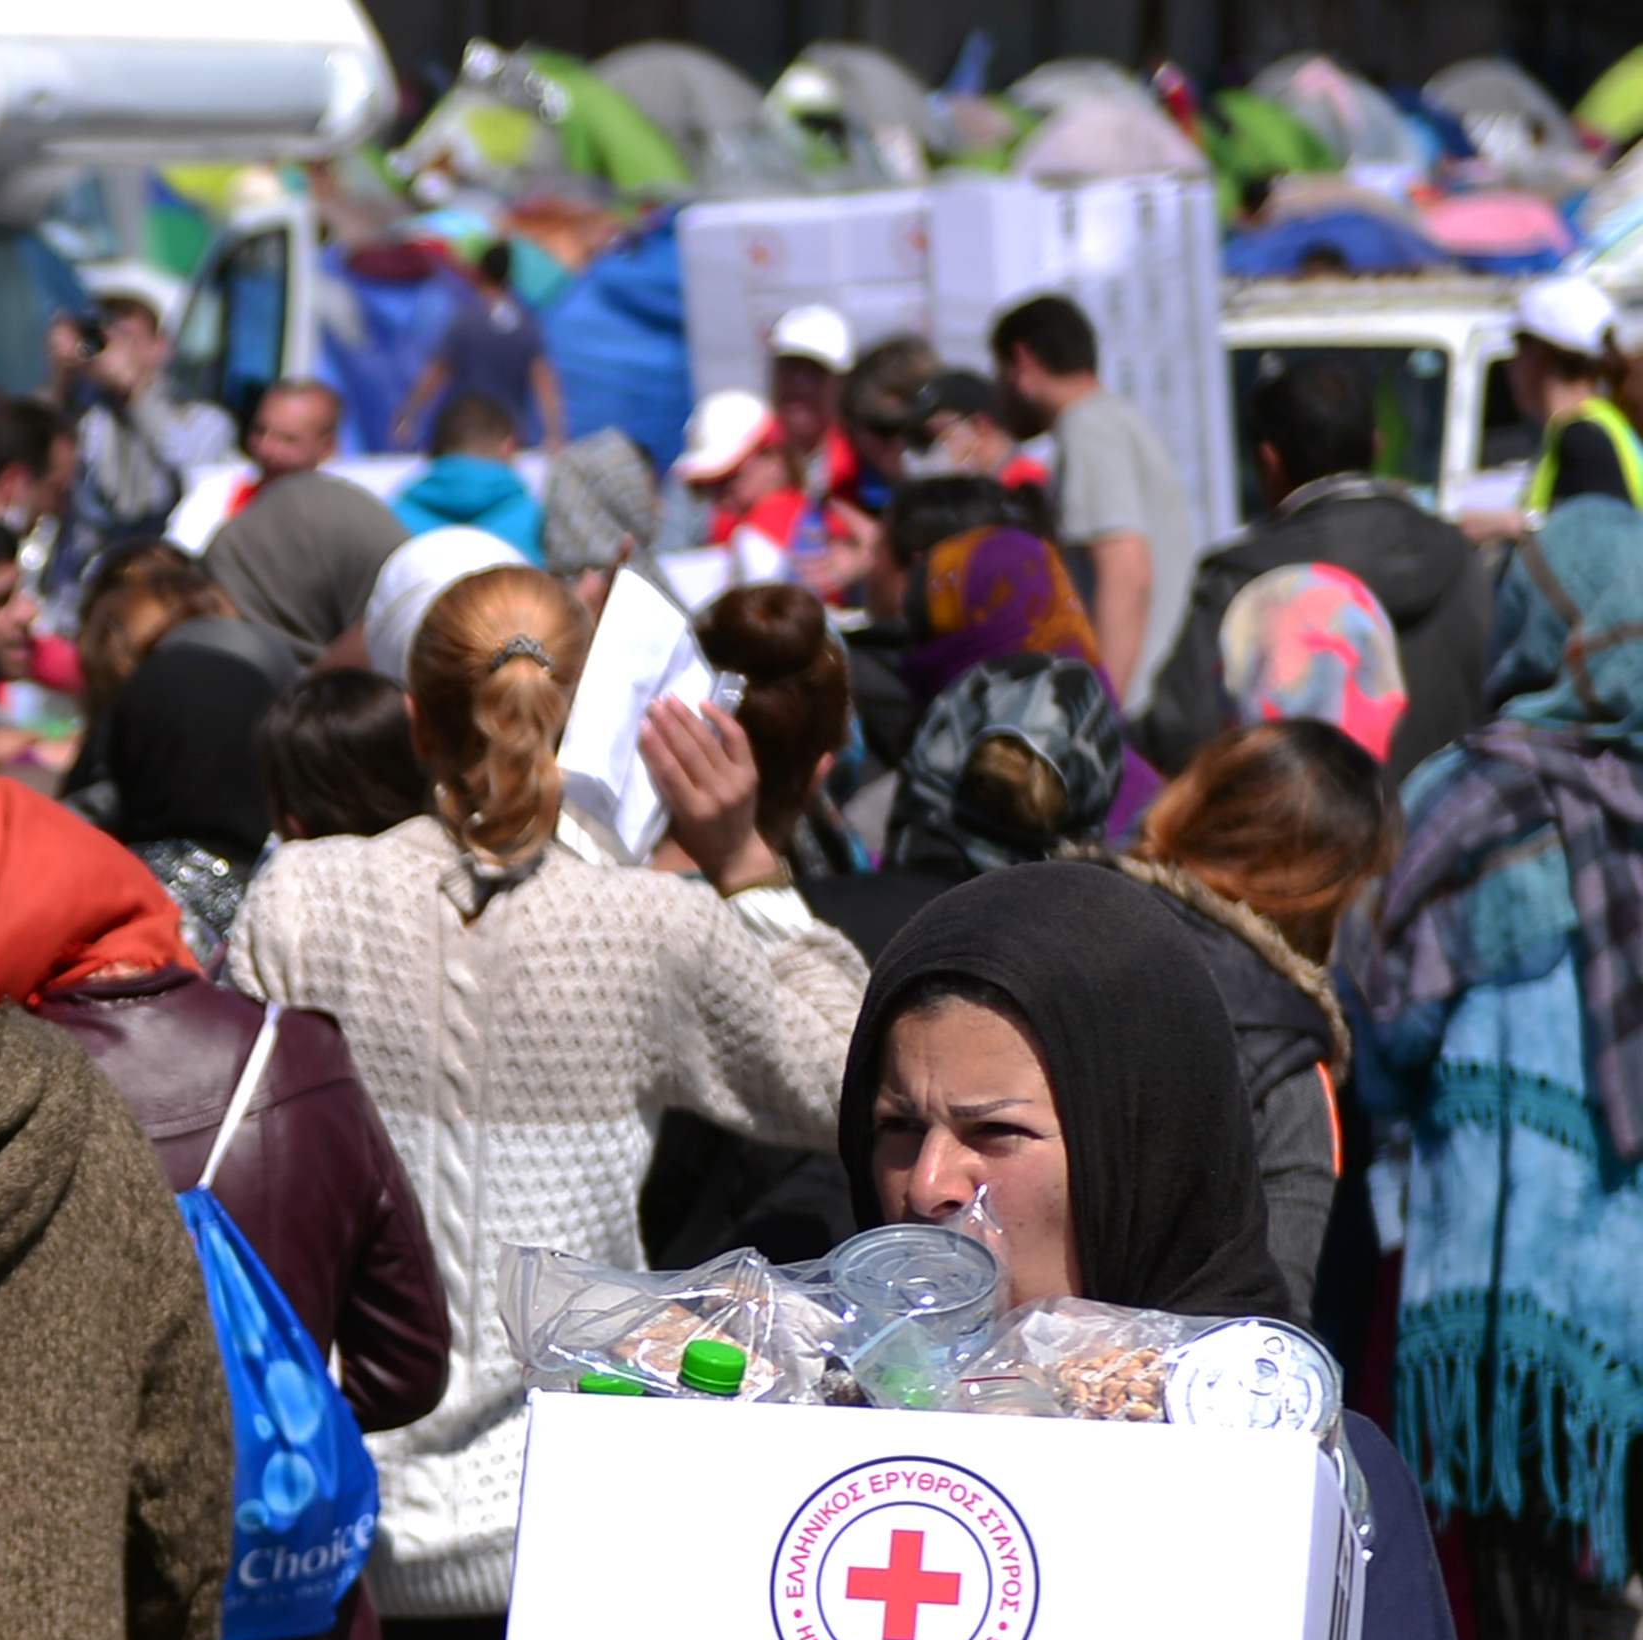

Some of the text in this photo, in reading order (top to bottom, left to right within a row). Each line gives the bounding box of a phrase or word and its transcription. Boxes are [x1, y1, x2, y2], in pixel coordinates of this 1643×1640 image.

[238, 1513, 375, 1588] Choice
[785, 1471, 1022, 1613] ΕΛΛΗΝΙΚΟΣ ΕΡΥΘΡΟΣ ΣΤΑΥΡΟΣ
